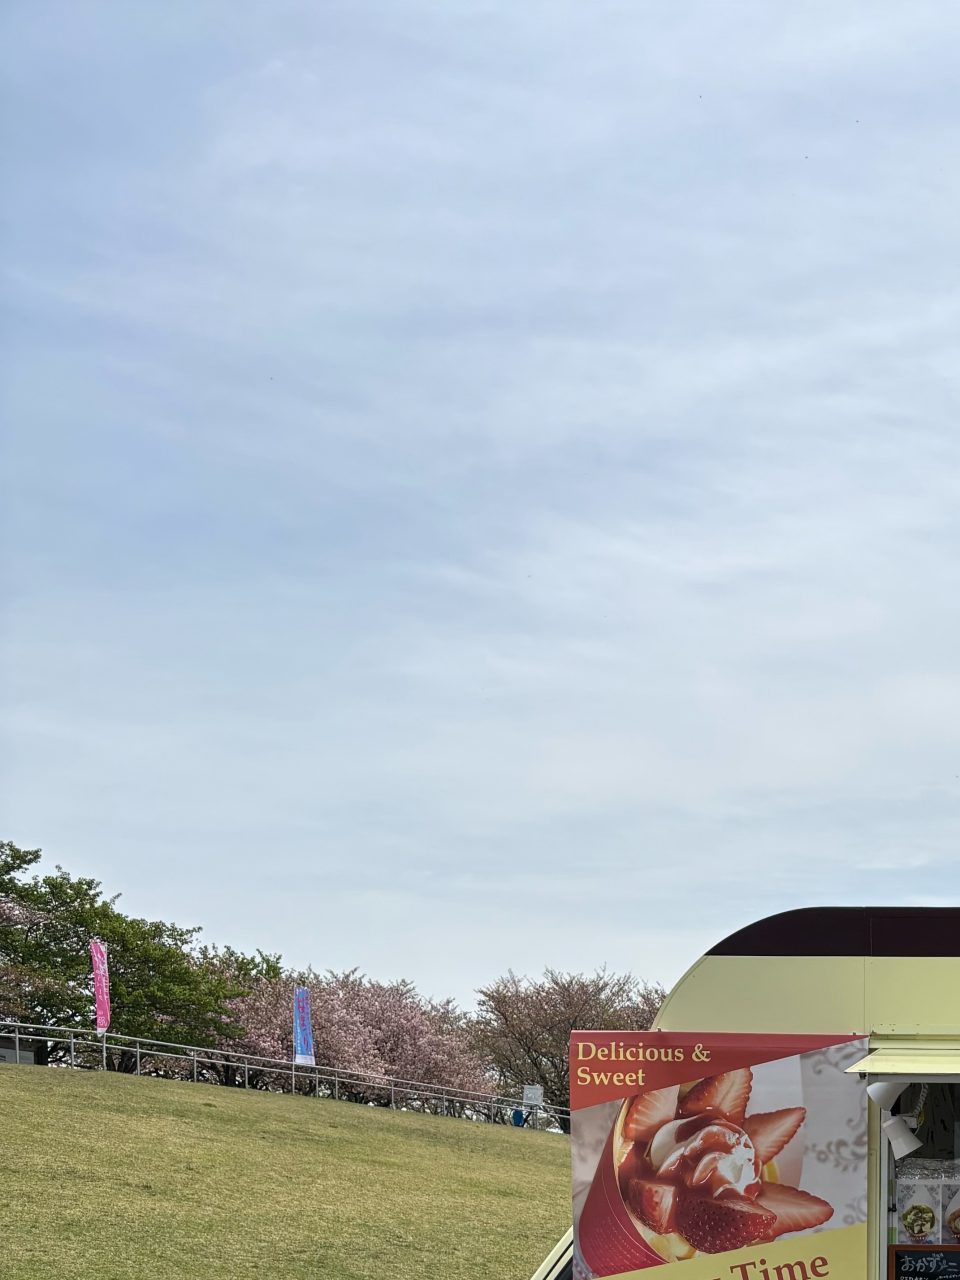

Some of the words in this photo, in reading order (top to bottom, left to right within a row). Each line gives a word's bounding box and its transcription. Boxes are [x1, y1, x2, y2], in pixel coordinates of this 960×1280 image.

[577, 1042, 684, 1063] Delicious
[691, 1043, 712, 1062] &
[576, 1067, 645, 1087] Sweet
